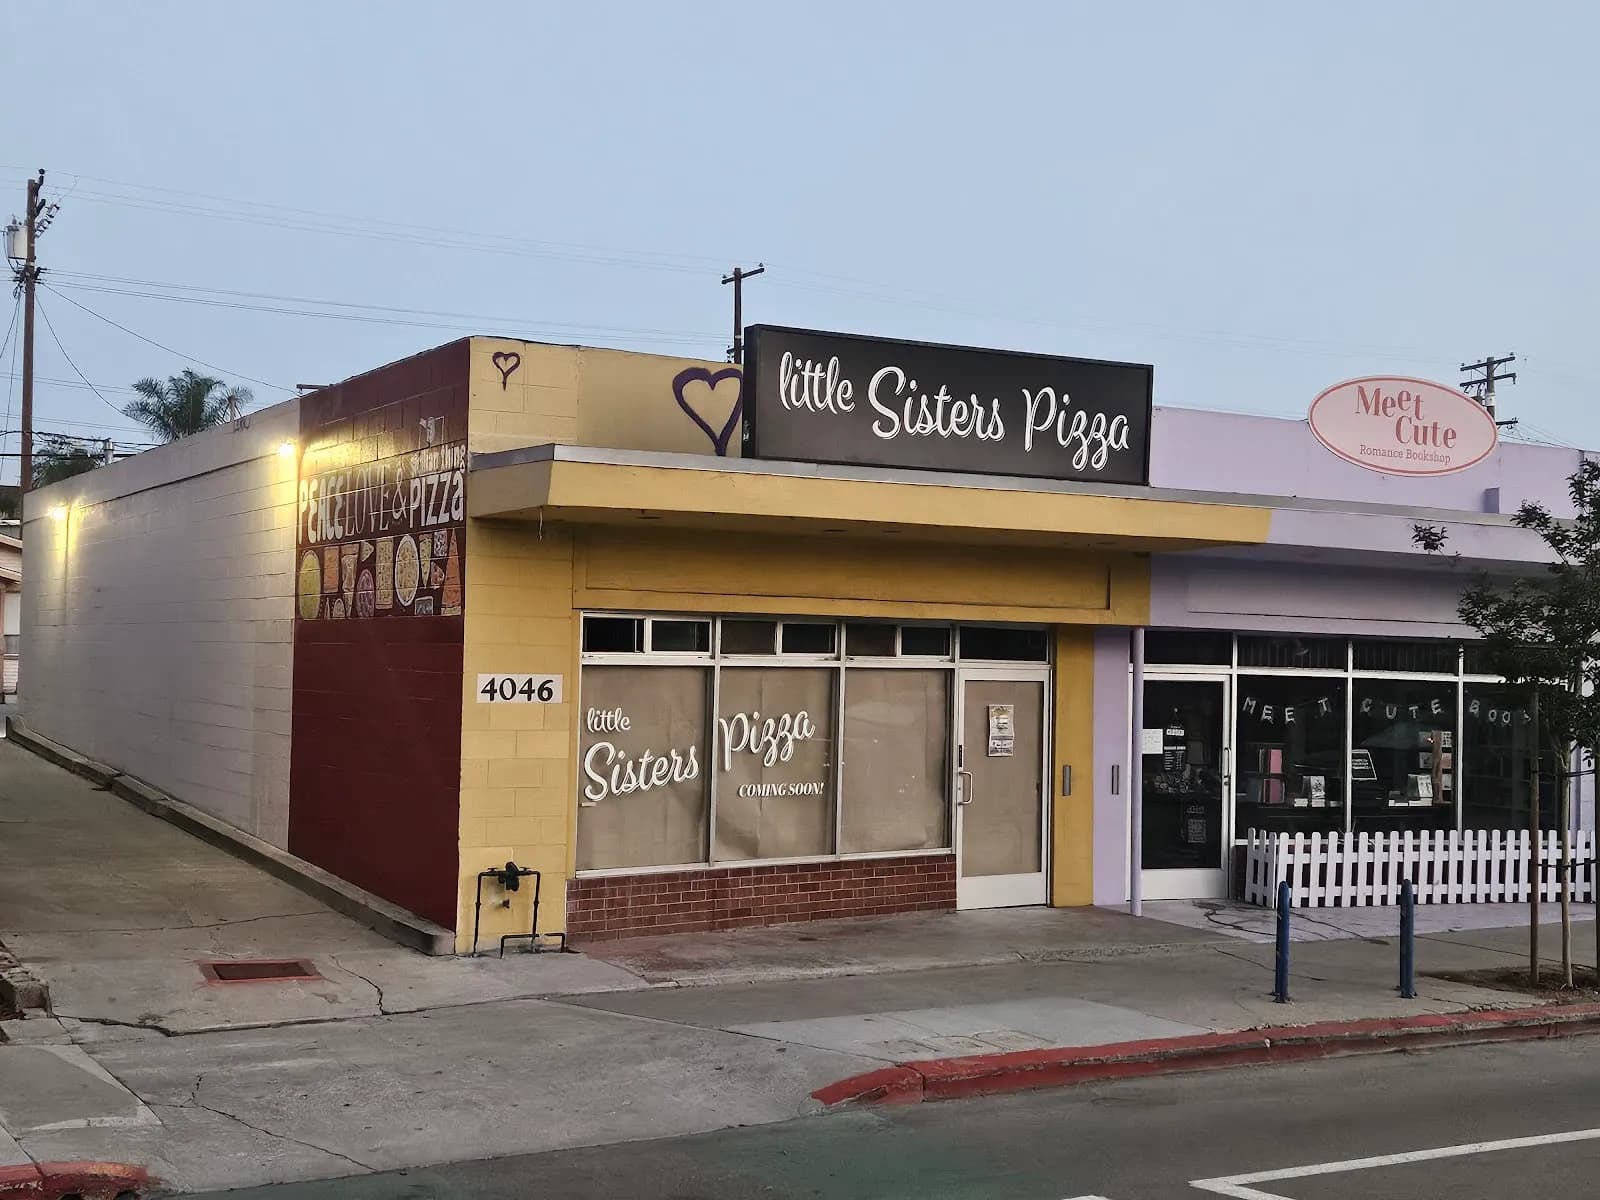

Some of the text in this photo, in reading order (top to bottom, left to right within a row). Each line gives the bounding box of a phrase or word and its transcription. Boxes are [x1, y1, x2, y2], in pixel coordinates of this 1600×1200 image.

[779, 351, 1130, 471] little Sisters Pizza
[1355, 385, 1424, 421] Meet
[1395, 415, 1457, 449] Cute
[1360, 444, 1451, 465] Romance Bookshop
[298, 475, 344, 544] PEACE
[344, 464, 390, 537] LOVE
[392, 467, 408, 520] &
[480, 677, 554, 702] 4046
[586, 707, 632, 733] little
[1242, 697, 1331, 722] MEET
[1360, 698, 1442, 720] CUTE
[717, 710, 816, 772] Pizza
[583, 741, 700, 802] Sisters
[738, 781, 825, 797] COMING SOON!
